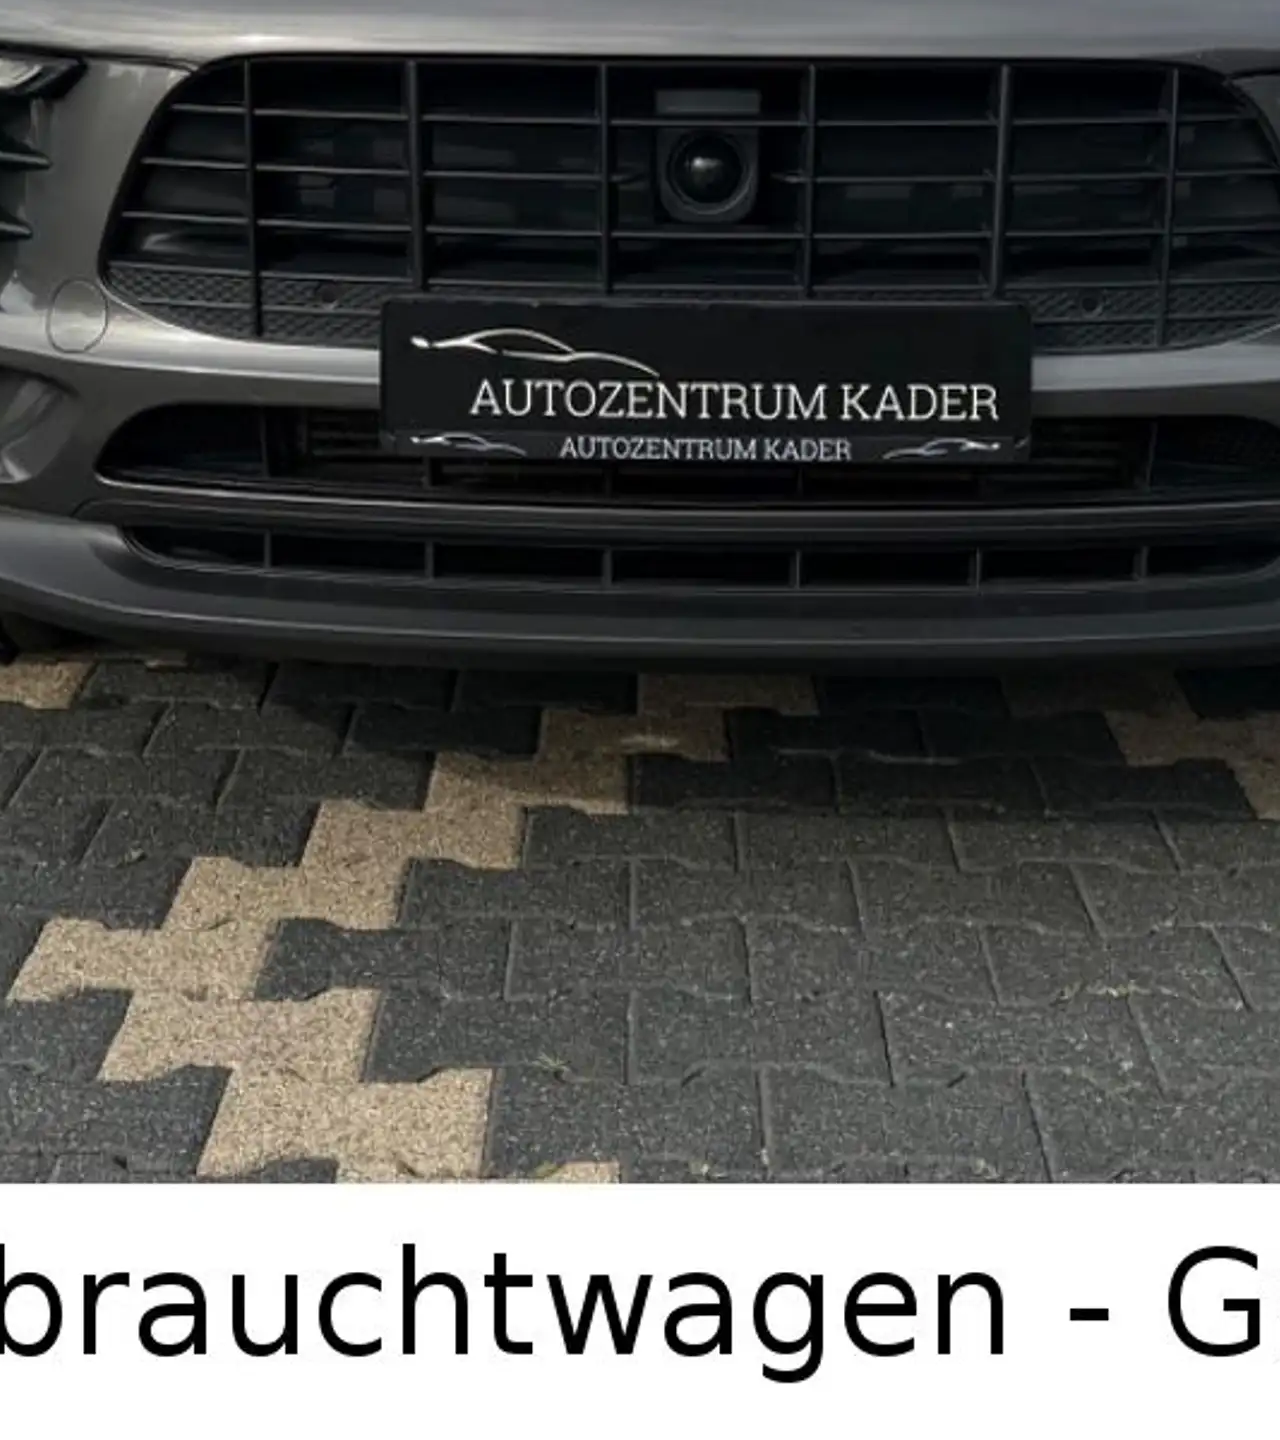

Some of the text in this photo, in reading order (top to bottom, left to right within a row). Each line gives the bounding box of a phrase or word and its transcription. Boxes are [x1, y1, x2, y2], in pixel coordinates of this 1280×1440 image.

[470, 379, 1000, 422] AUTOZENTRUM KADER
[559, 435, 852, 462] AUTOZENTRUM KADER
